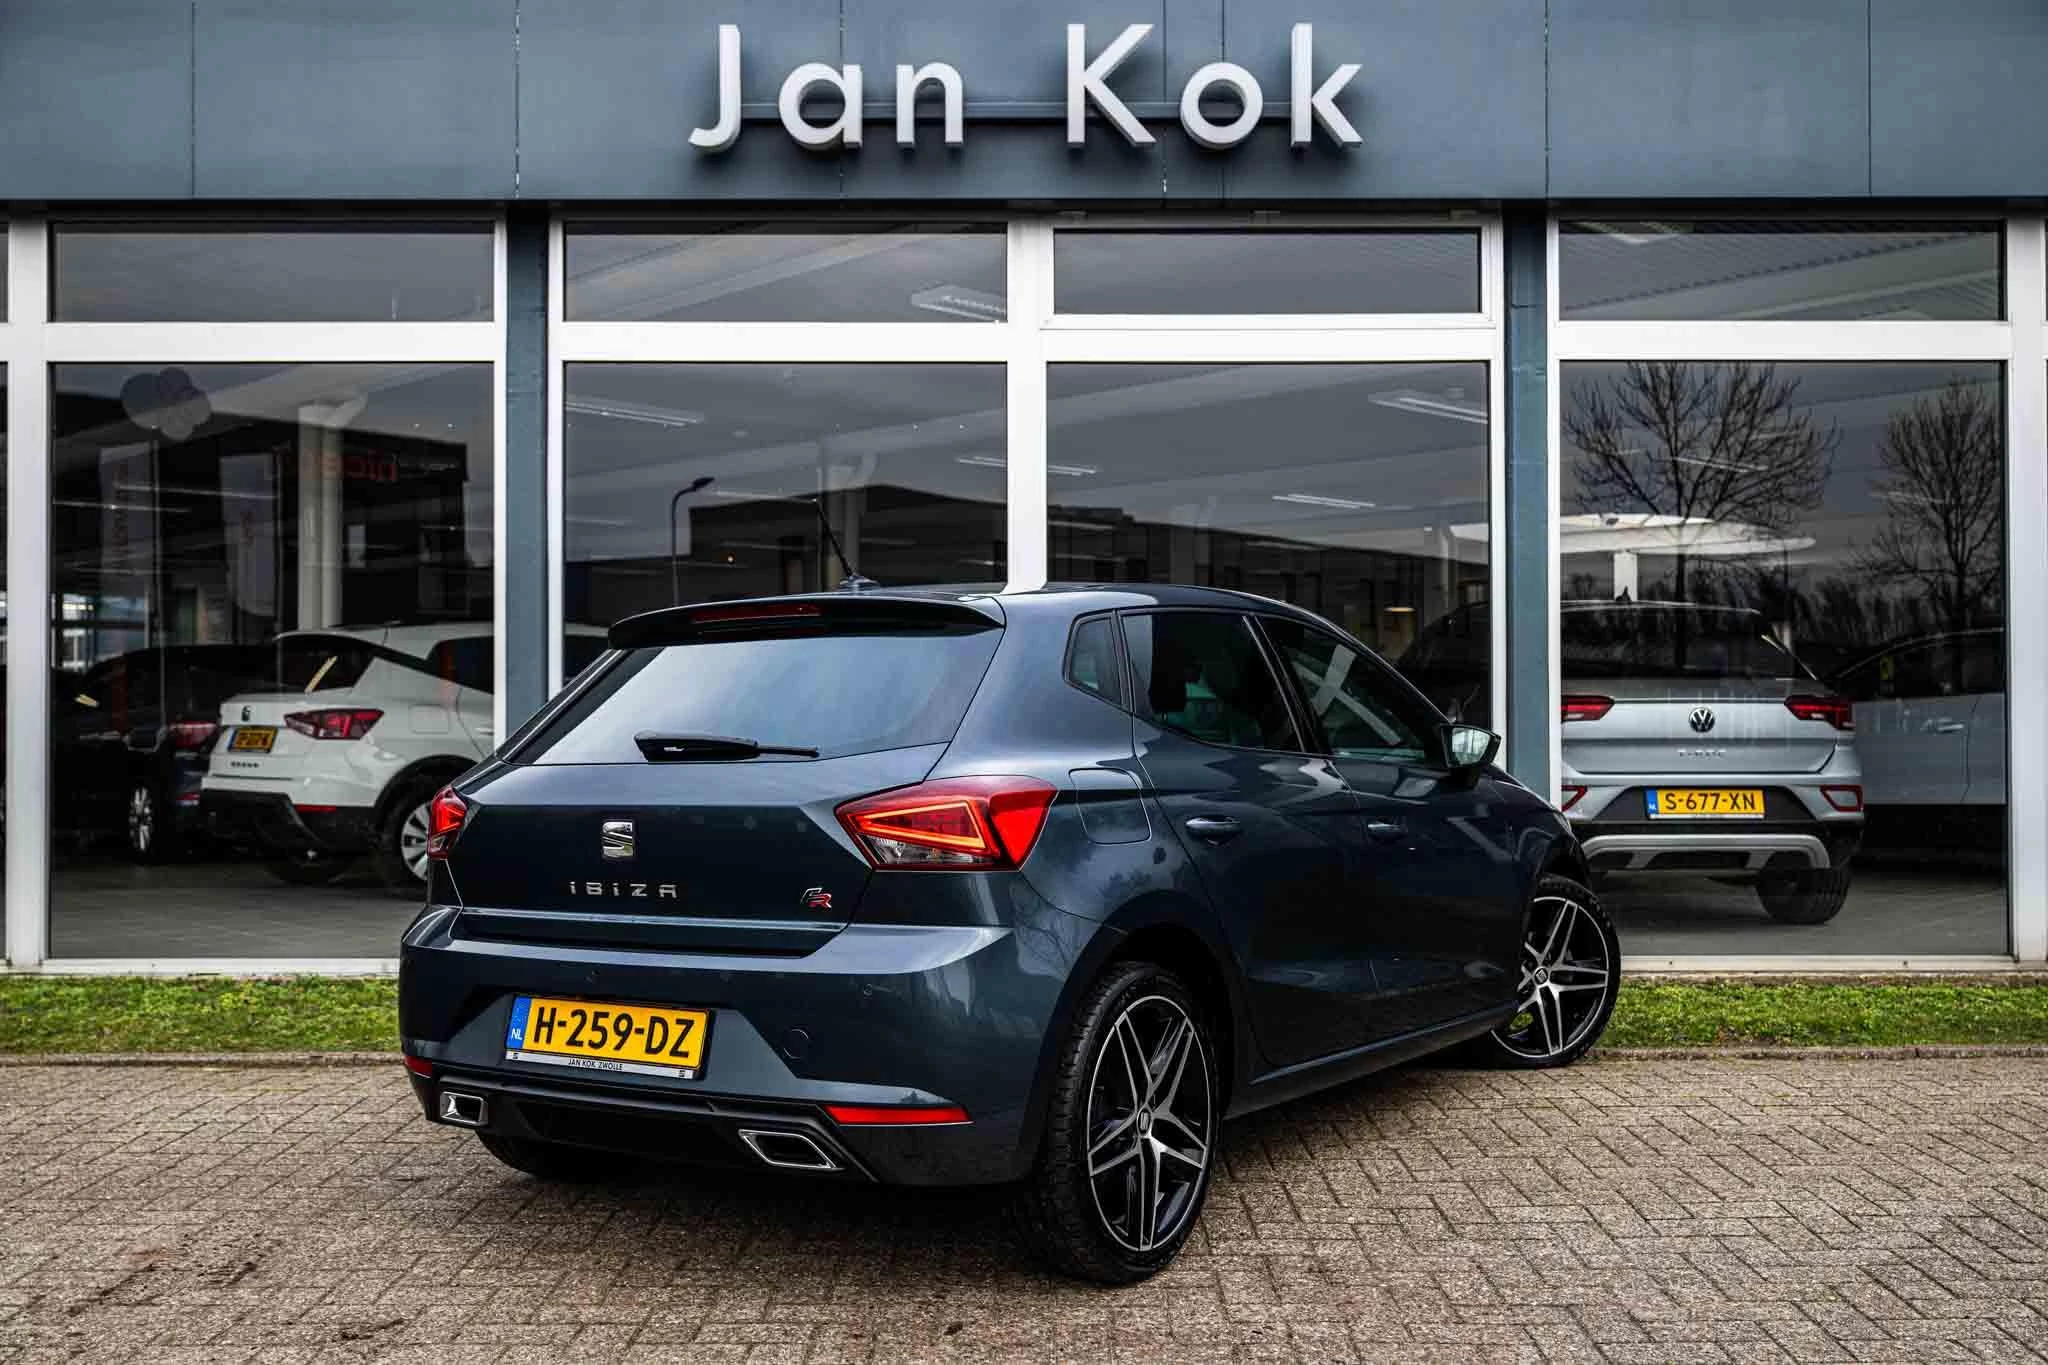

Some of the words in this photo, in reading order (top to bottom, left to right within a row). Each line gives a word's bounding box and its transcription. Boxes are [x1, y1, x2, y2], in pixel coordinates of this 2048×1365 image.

[688, 24, 963, 150] Jan
[1066, 24, 1363, 150] Kok
[1665, 792, 1755, 810] S-677-XN
[511, 1028, 523, 1041] NL
[533, 1006, 694, 1058] H-259-DZ
[568, 1058, 581, 1066] JAN
[598, 1061, 623, 1071] ZWOLLE
